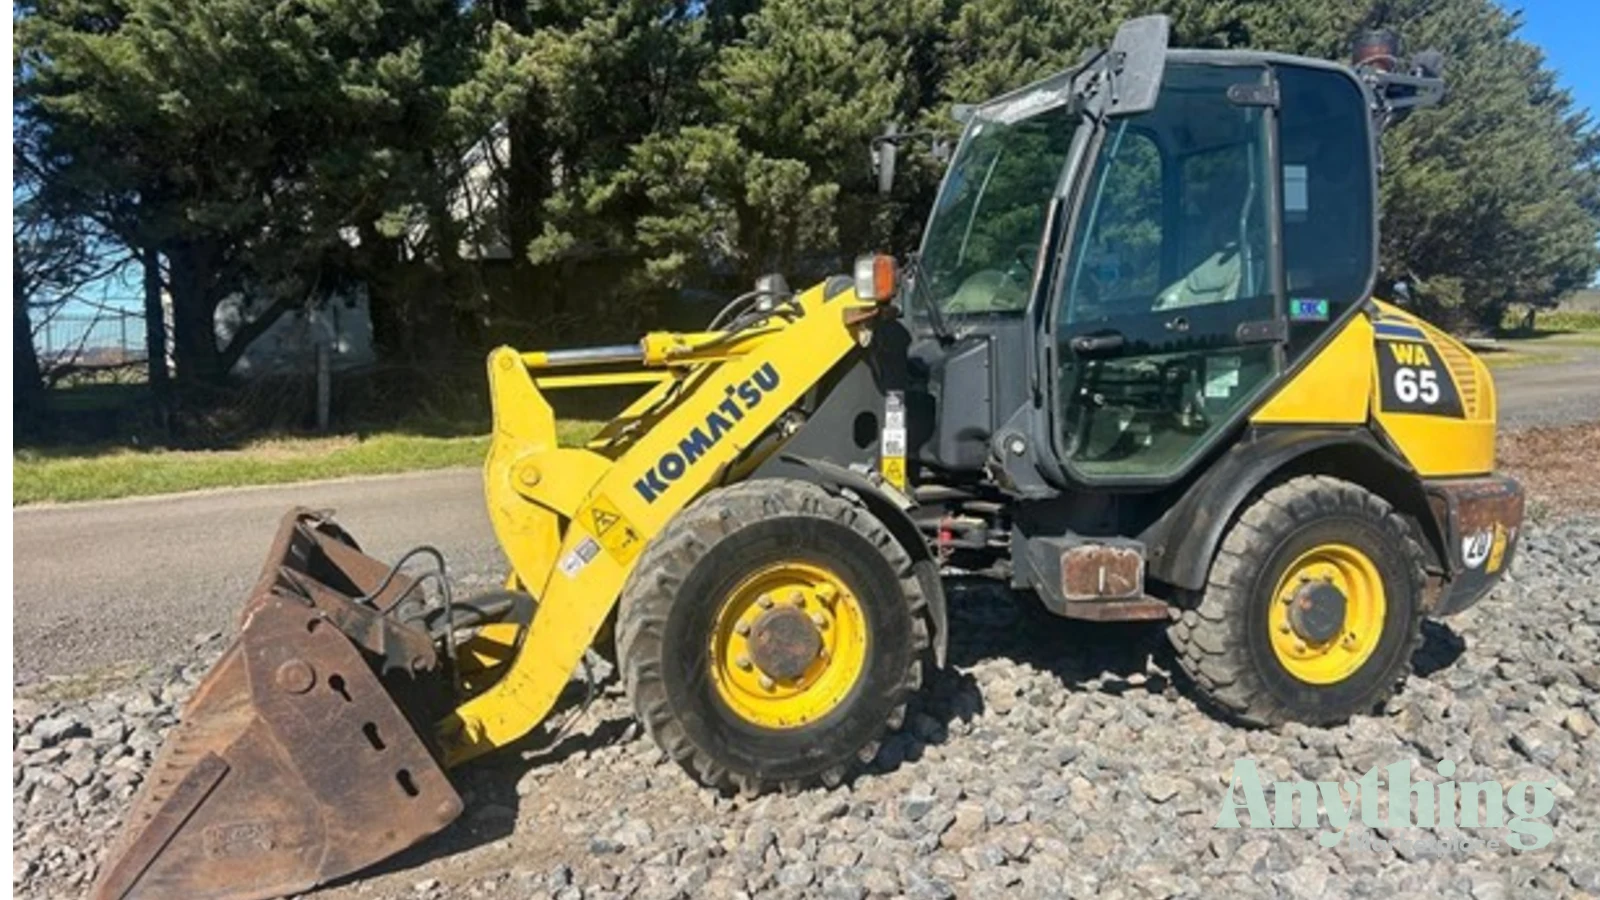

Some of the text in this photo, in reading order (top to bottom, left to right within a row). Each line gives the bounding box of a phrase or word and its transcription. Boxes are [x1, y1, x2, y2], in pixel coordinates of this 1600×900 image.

[1390, 343, 1430, 366] WA
[1394, 368, 1440, 404] 65
[634, 362, 780, 504] KOMATSU
